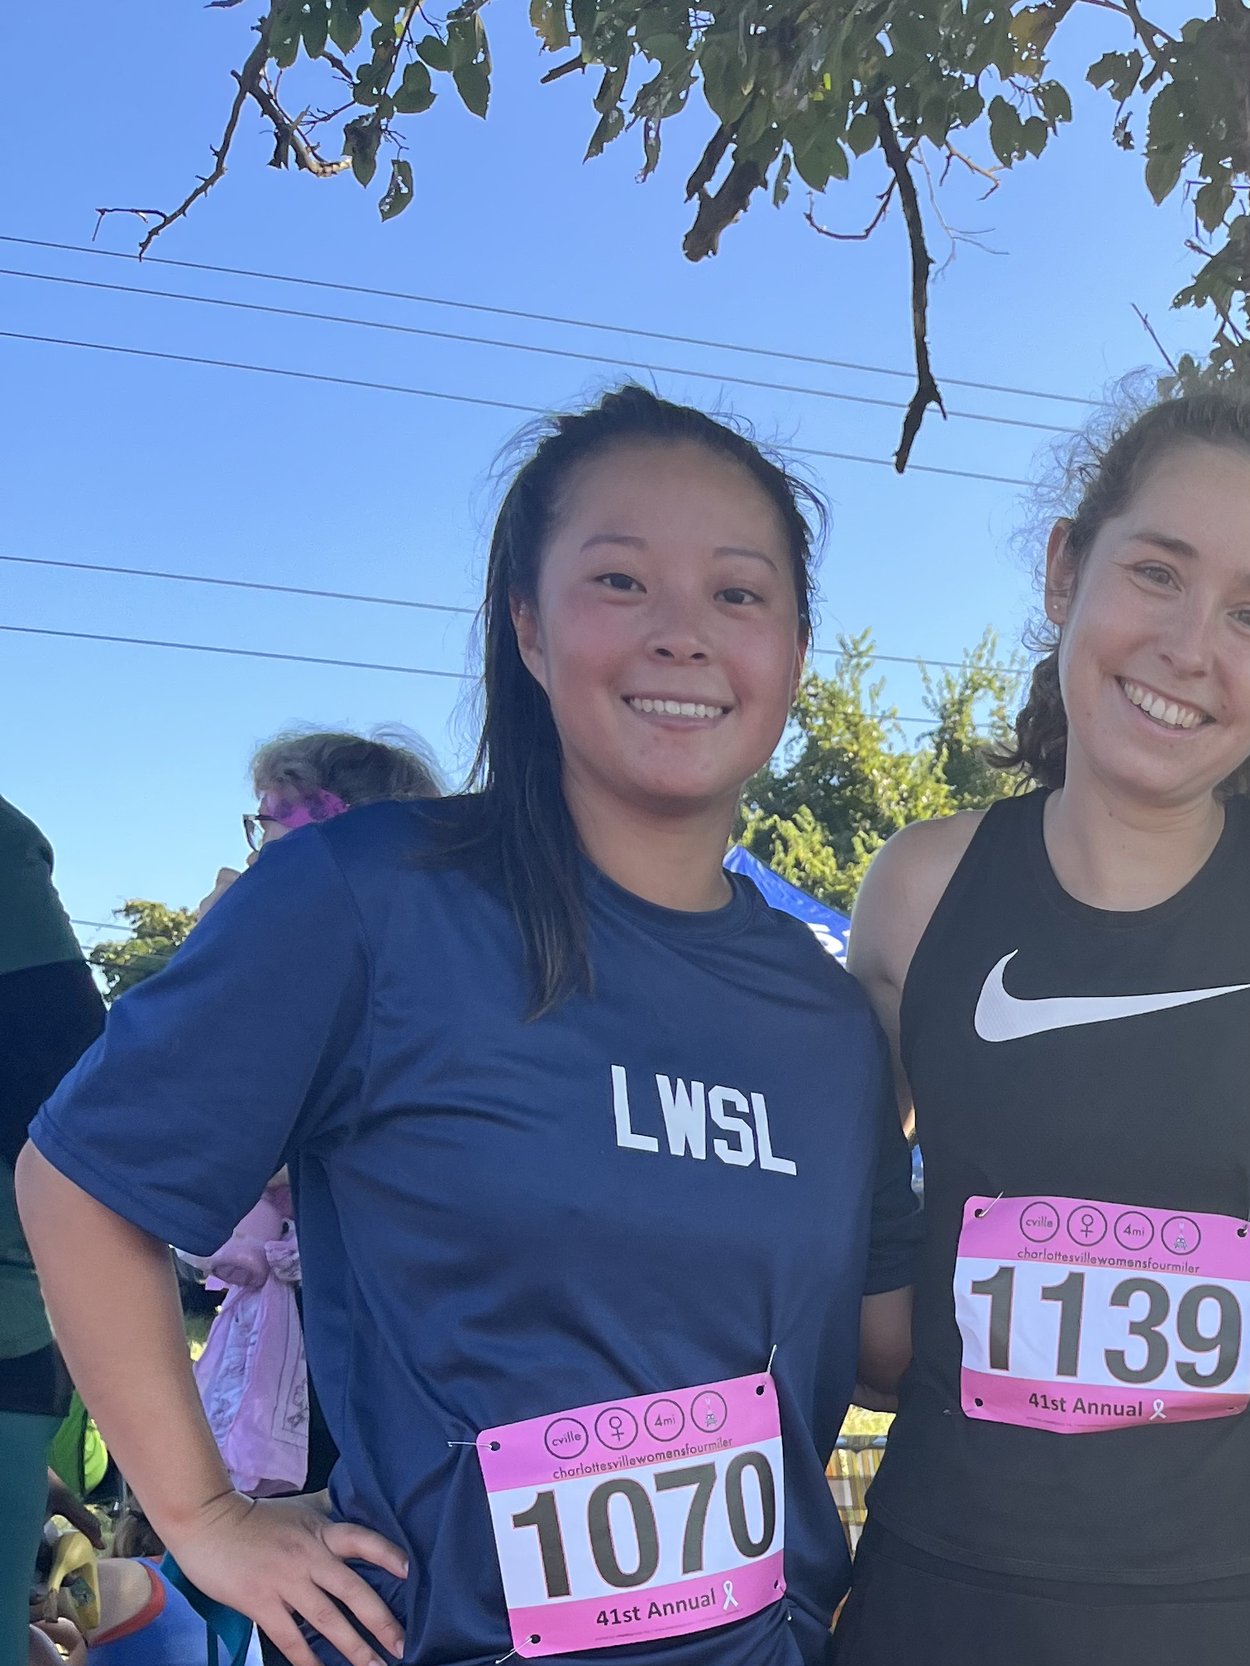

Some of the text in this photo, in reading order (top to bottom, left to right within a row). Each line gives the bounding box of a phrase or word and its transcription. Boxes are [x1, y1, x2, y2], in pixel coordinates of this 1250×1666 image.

[610, 1064, 797, 1176] LWSL
[1025, 1216, 1053, 1228] cville
[1123, 1223, 1145, 1237] 4mi
[1017, 1247, 1200, 1274] charlottesvillewomensfourmiler
[970, 1265, 1242, 1389] 1139
[1028, 1392, 1143, 1417] 41st Annual
[654, 1413, 676, 1427] 4mi
[552, 1431, 582, 1447] cville
[553, 1437, 733, 1480] charlottesvillewomensfourmiler
[511, 1450, 776, 1600] 1070
[596, 1606, 642, 1626] 41st
[647, 1589, 716, 1619] Annual
